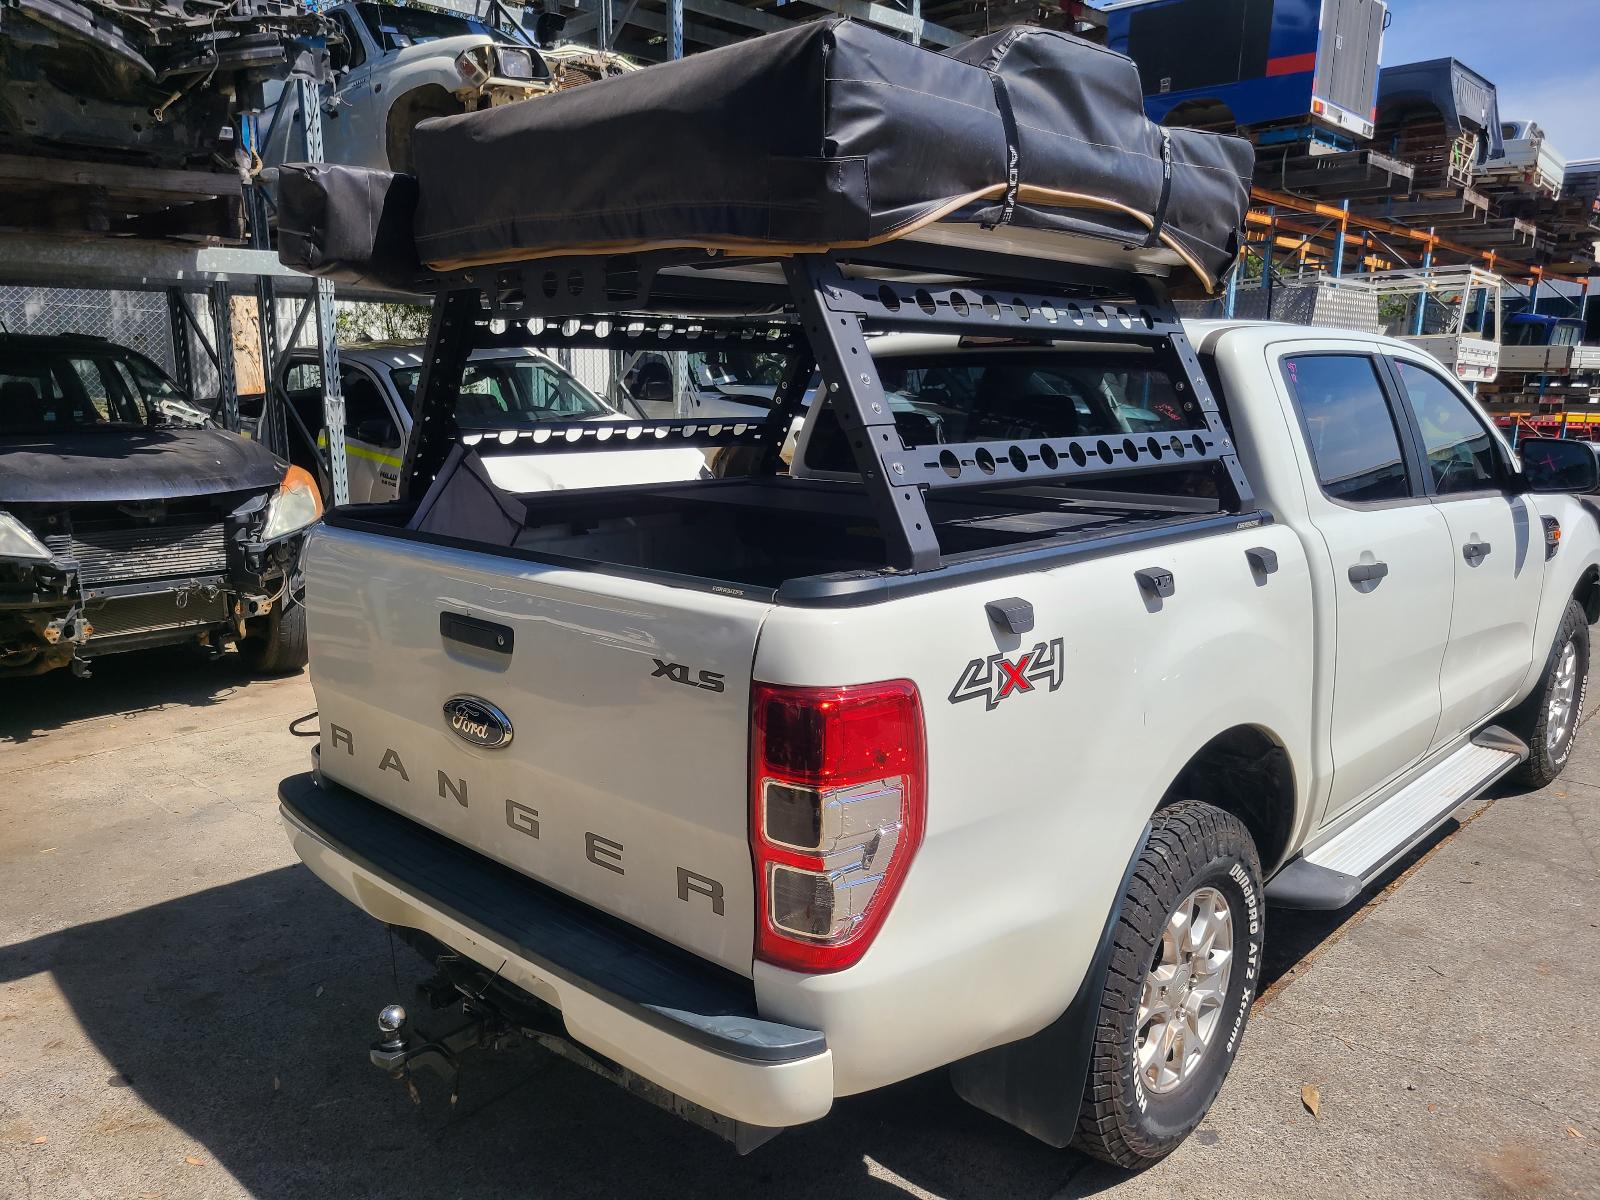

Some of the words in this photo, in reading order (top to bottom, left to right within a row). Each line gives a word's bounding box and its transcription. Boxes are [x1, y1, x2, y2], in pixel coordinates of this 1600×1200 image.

[651, 658, 725, 693] XLS
[452, 702, 489, 739] Ford
[330, 722, 725, 917] RANGER
[1245, 941, 1259, 980] AT2
